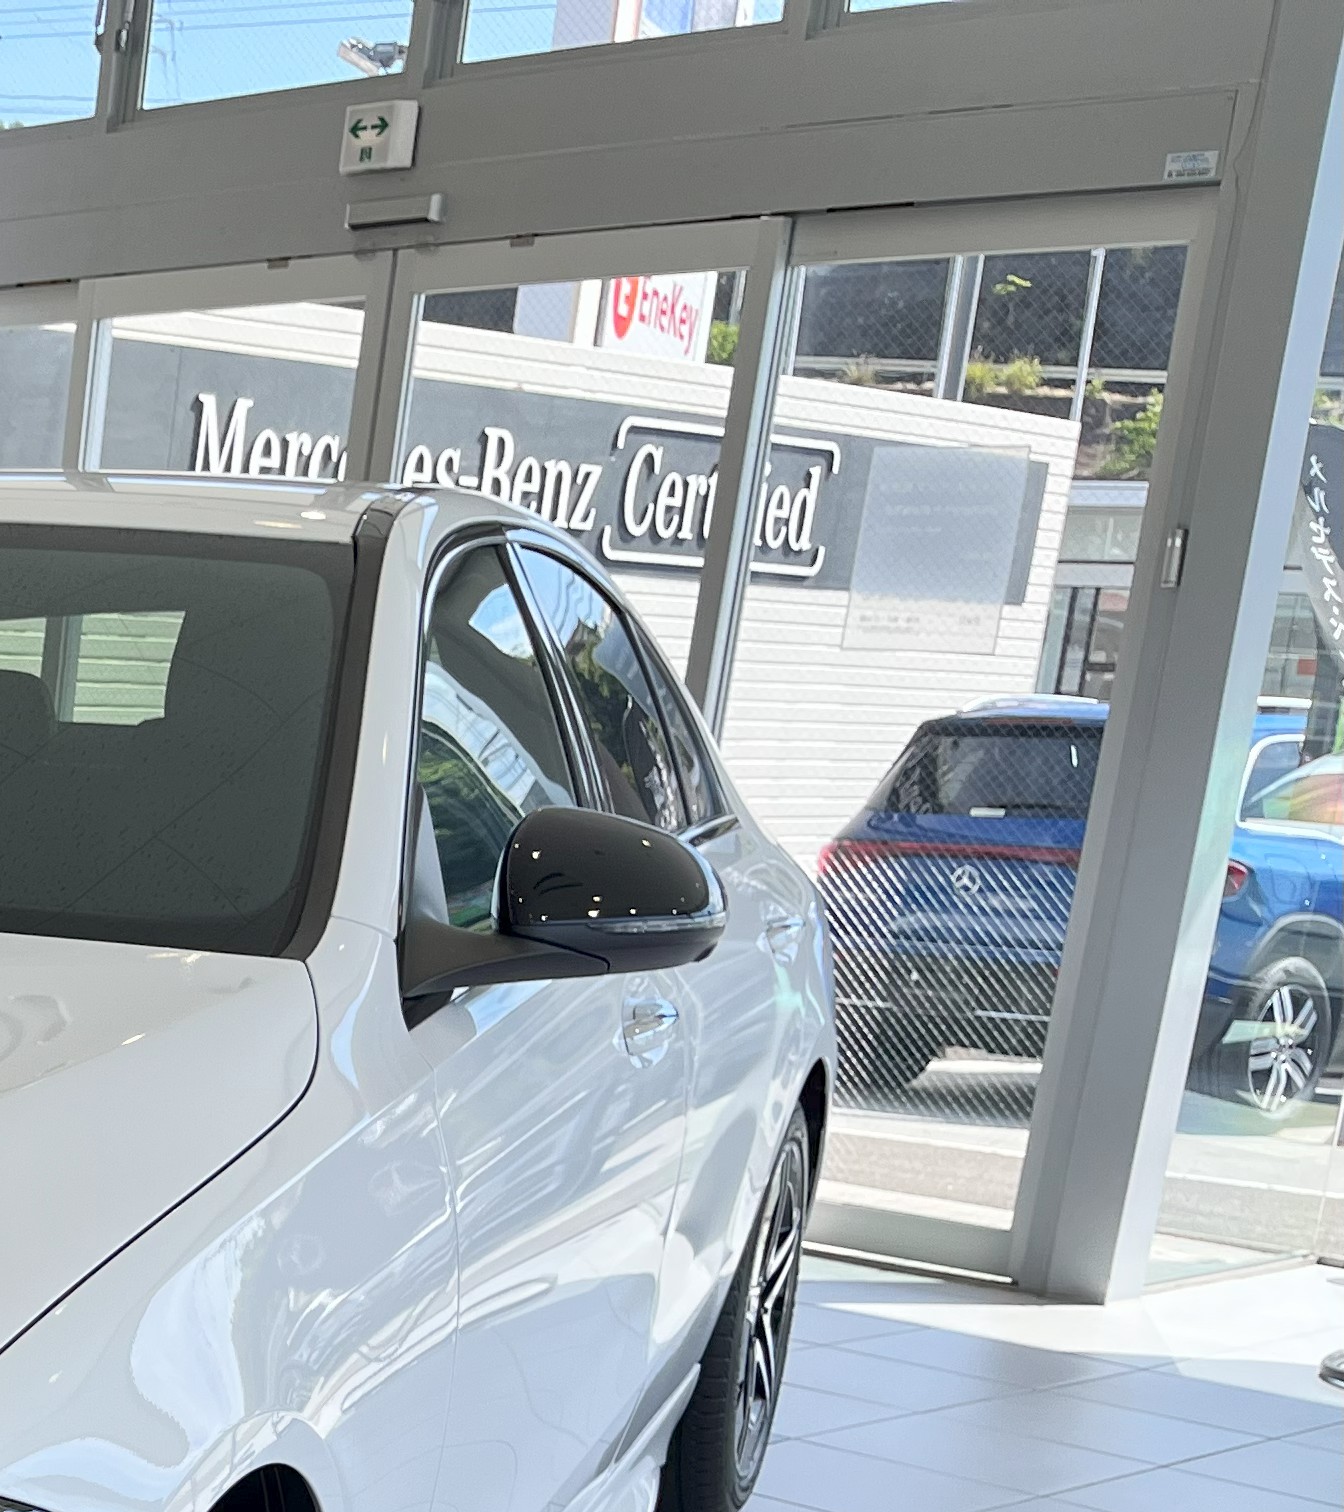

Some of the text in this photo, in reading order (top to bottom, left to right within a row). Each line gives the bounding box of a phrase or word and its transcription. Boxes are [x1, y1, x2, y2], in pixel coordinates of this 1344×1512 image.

[638, 276, 700, 356] EneKey
[195, 392, 822, 552] Merces-Benz Certied
